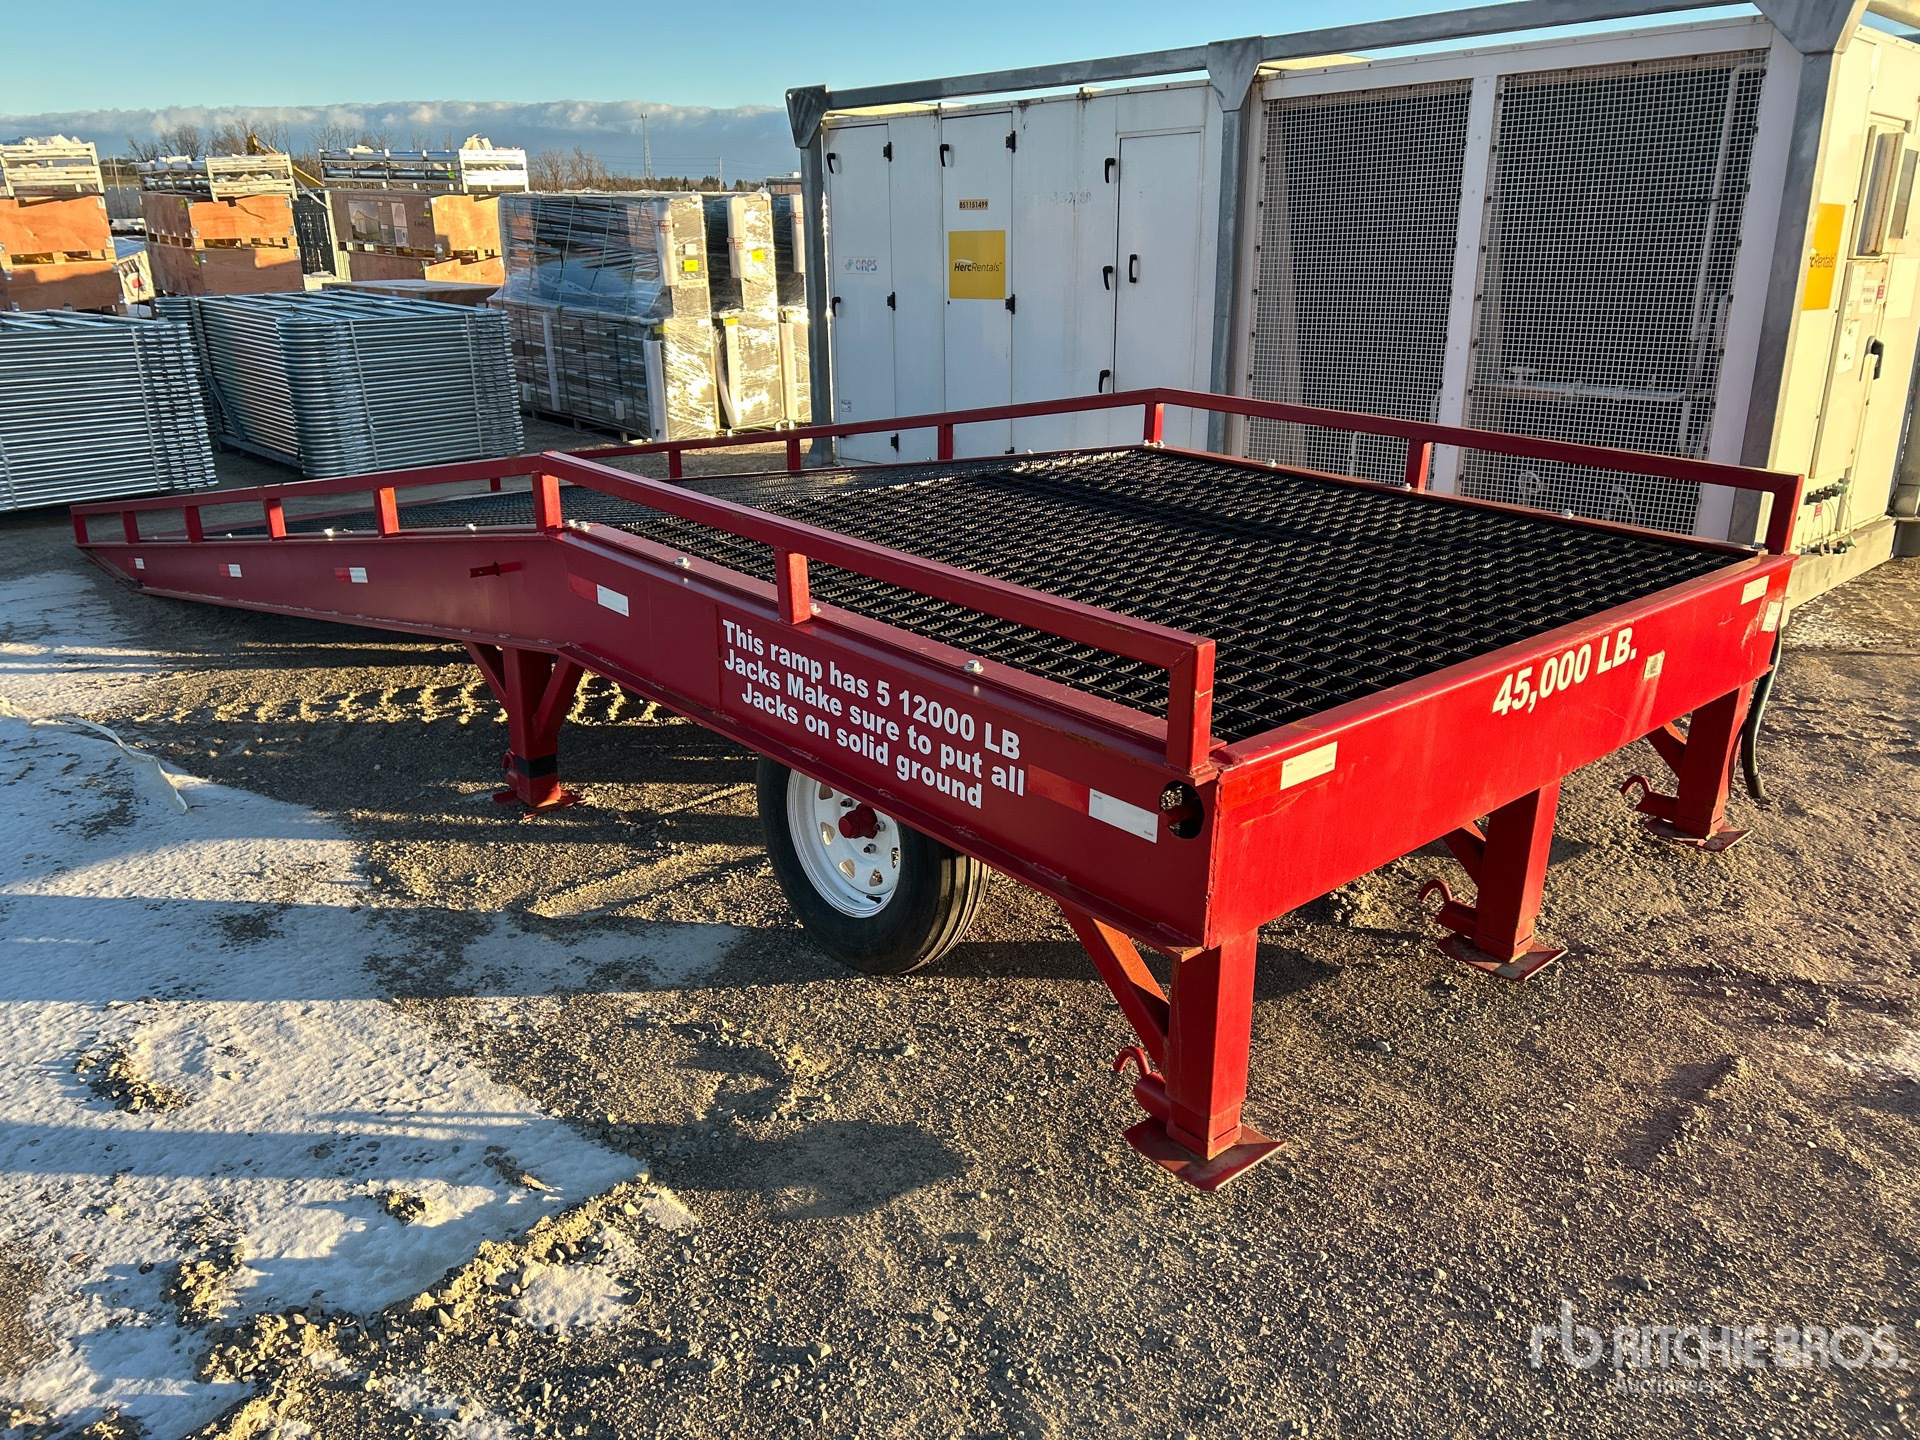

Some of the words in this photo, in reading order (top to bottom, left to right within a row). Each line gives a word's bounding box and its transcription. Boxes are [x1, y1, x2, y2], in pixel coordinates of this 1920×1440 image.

[953, 261, 1001, 272] HercRentals
[722, 619, 764, 656] This
[770, 643, 823, 684] ramp
[829, 660, 869, 699] has
[876, 679, 890, 707] 5
[899, 689, 975, 742] 12000
[984, 722, 1020, 760] LB
[724, 648, 781, 691] Jacks
[787, 672, 843, 717] Make
[849, 705, 900, 741] sure
[907, 724, 932, 755] to
[940, 743, 983, 779] put
[991, 765, 1025, 797] all
[1492, 643, 1592, 716] 45,000
[1596, 627, 1637, 675] LB.
[741, 682, 799, 725] Jacks
[804, 714, 830, 740] on
[836, 728, 889, 767] solid
[896, 754, 982, 809] ground
